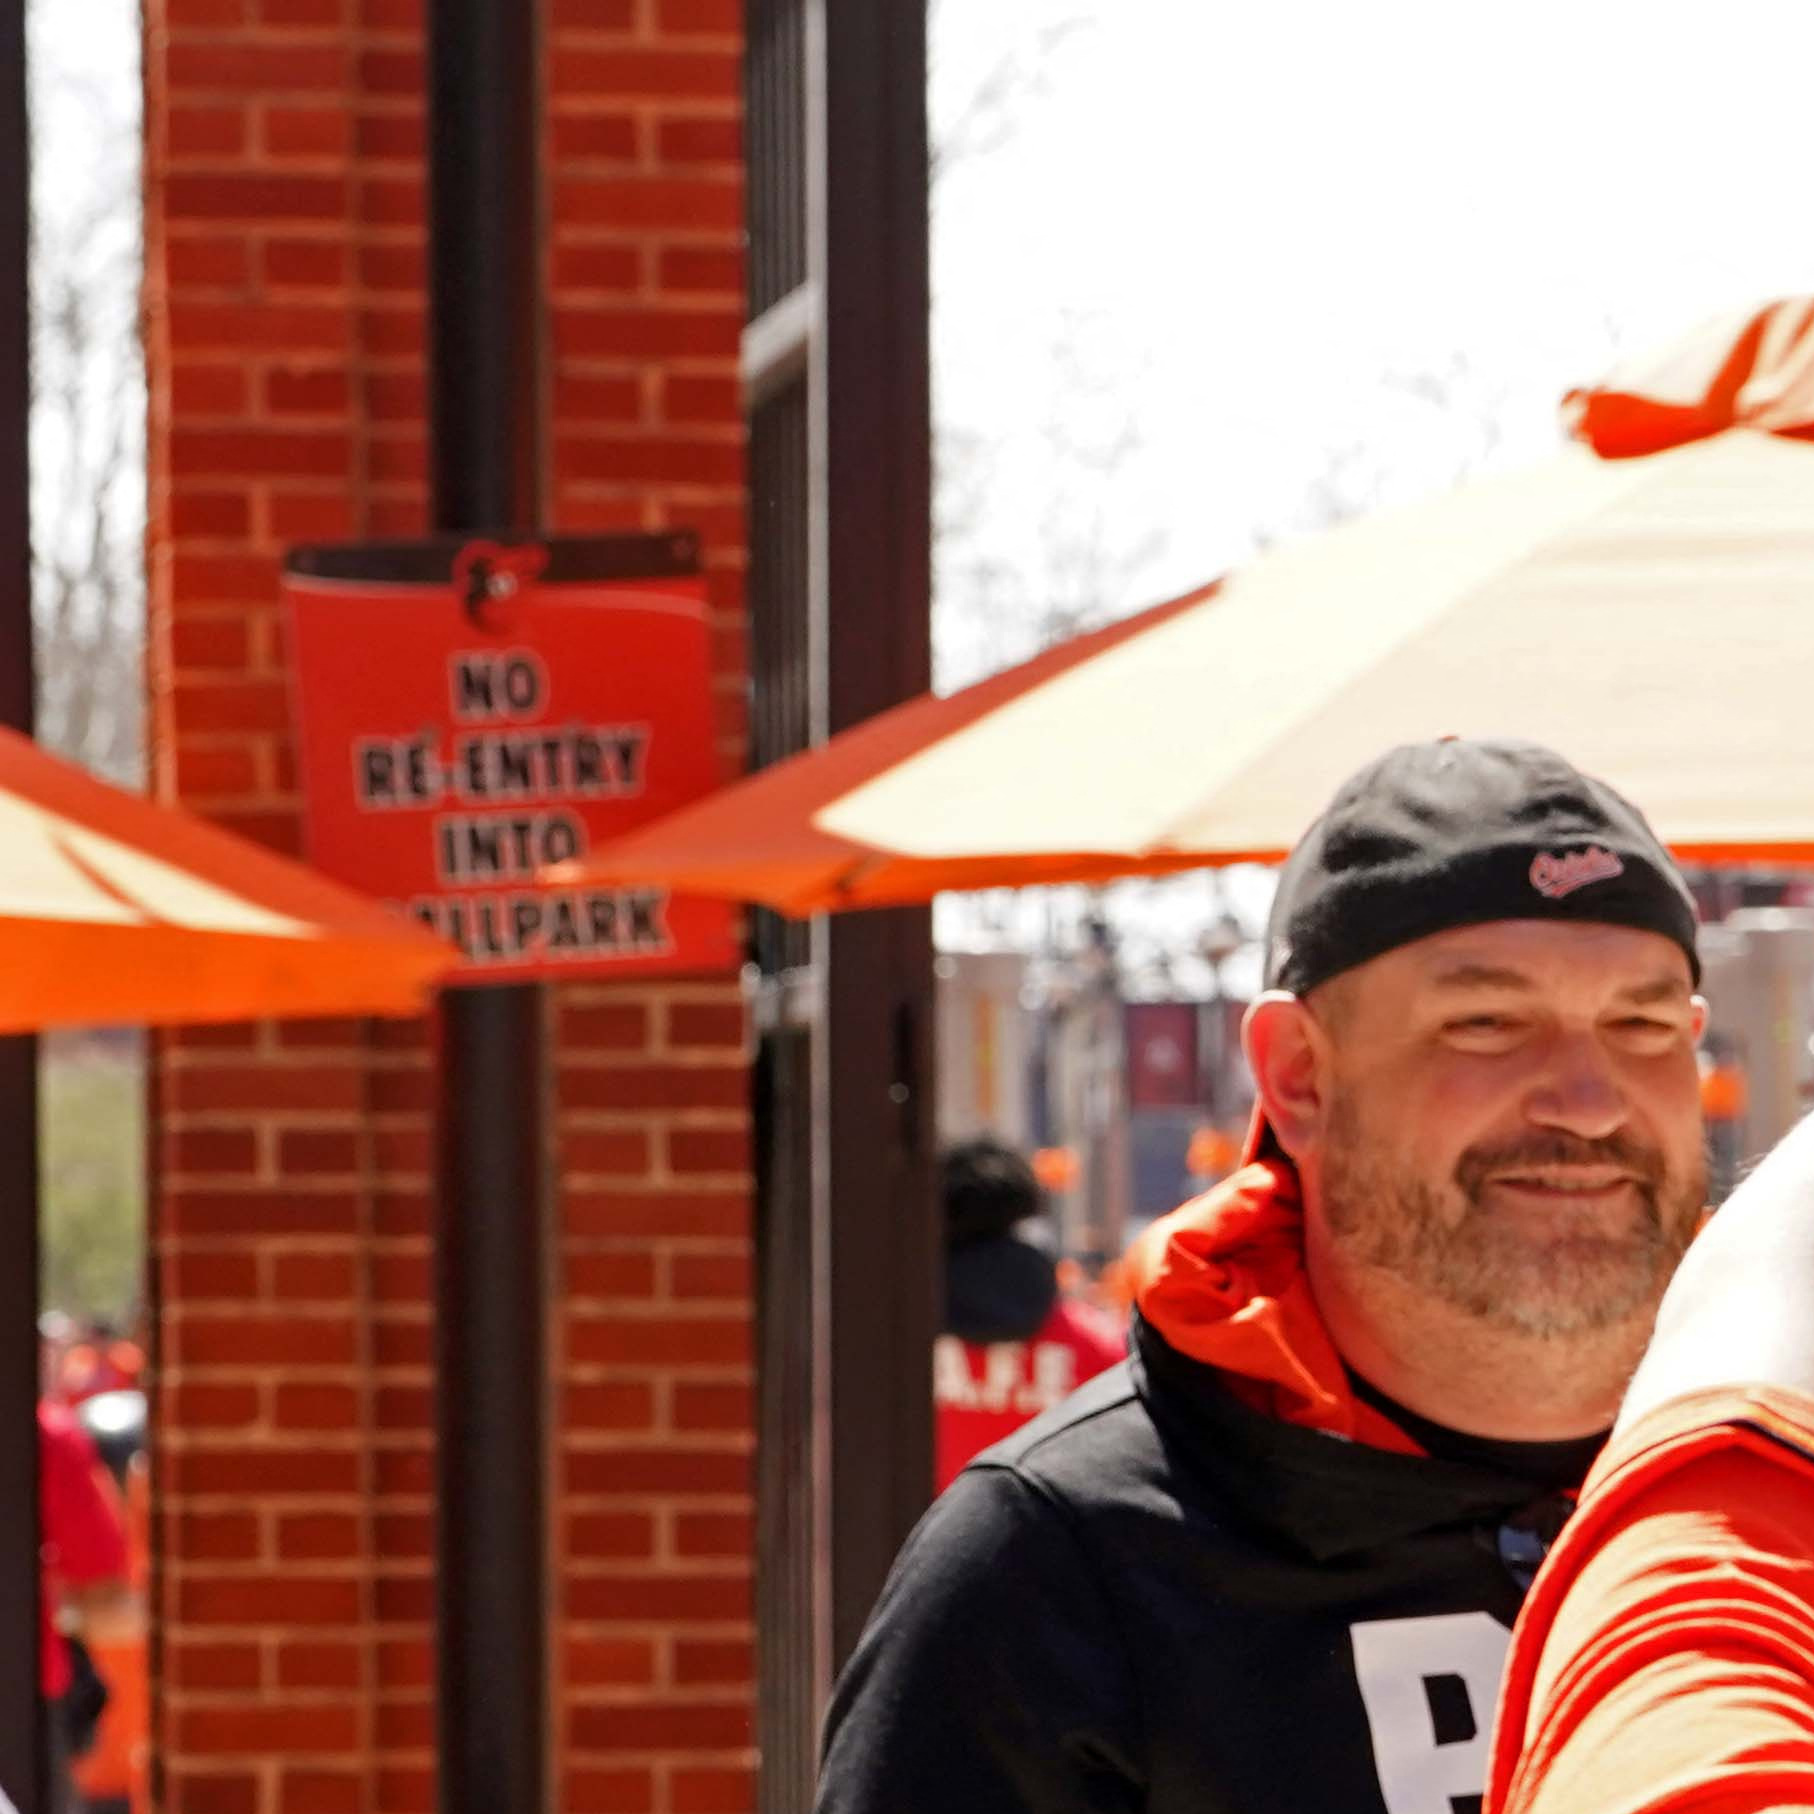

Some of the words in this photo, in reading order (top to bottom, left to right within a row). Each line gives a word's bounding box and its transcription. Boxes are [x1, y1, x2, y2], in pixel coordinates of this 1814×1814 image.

[451, 648, 547, 720] NO
[353, 726, 650, 809] RE-ENTRY
[435, 812, 586, 886] INTO
[408, 890, 672, 965] LLPARK
